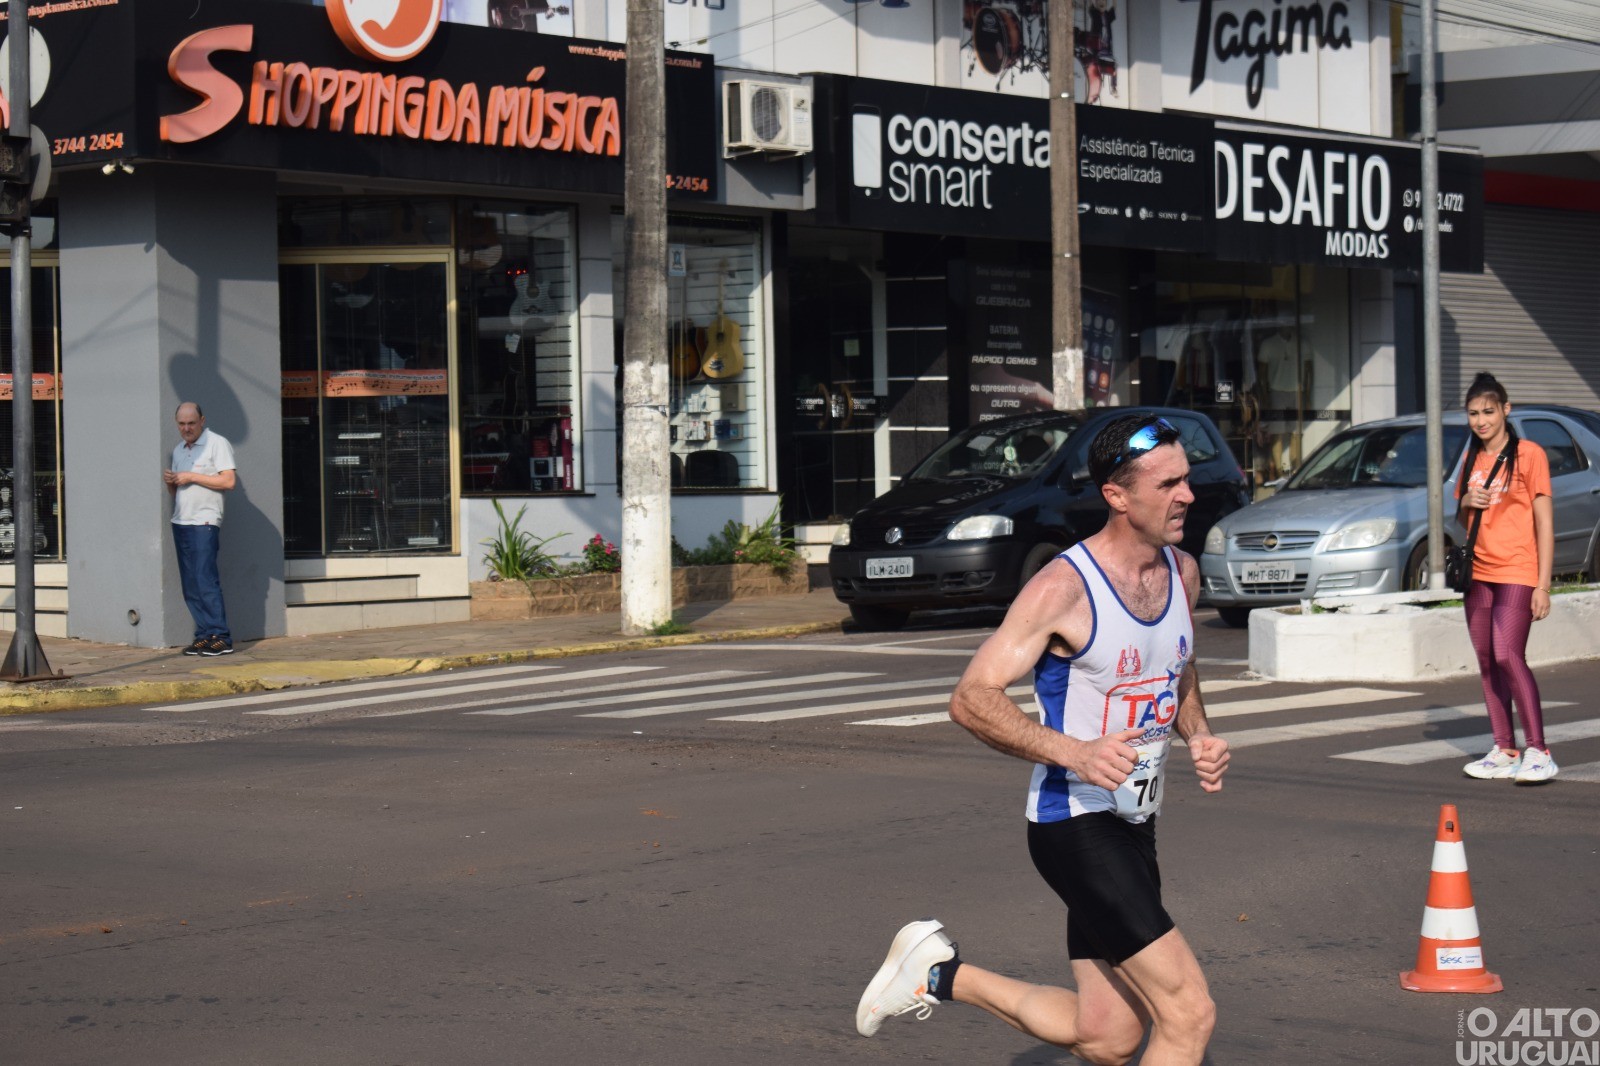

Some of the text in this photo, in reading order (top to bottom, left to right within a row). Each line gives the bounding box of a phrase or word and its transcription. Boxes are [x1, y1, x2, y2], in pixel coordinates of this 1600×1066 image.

[160, 24, 426, 143] SHOPPING
[484, 66, 621, 156] MÚSICA
[53, 132, 124, 155] 3744 2454
[887, 114, 1050, 168] conserta
[1080, 134, 1196, 163] Assistência Técnica
[1080, 159, 1162, 184] Especializada
[888, 161, 993, 210] smart
[1214, 139, 1391, 232] DESAFIO
[1095, 206, 1119, 216] NOKIA
[1158, 212, 1178, 220] SONY
[1325, 231, 1389, 259] MODAS
[976, 296, 1032, 308] QUEBRADA
[989, 325, 1019, 335] BATERIA
[1006, 356, 1038, 365] DEMAIS
[970, 384, 980, 392] ou
[981, 384, 1016, 394] apresenta
[991, 399, 1021, 408] OUTRO
[1121, 690, 1176, 729] TAG
[1134, 775, 1158, 807] 70
